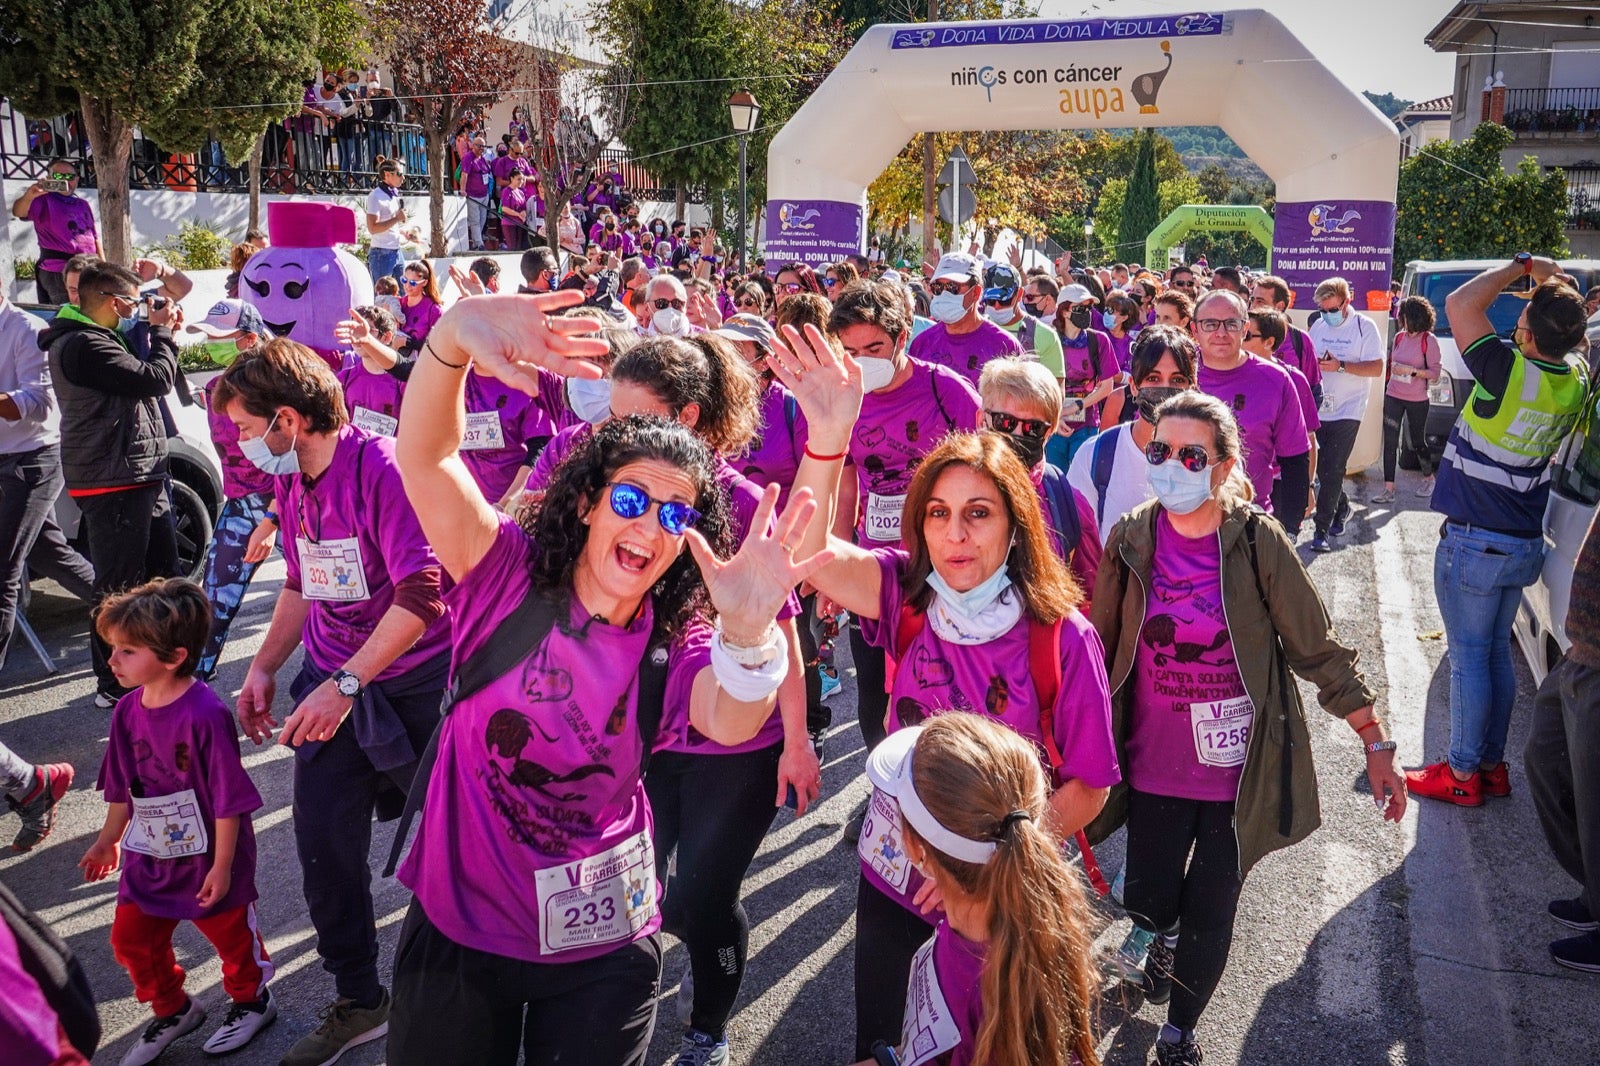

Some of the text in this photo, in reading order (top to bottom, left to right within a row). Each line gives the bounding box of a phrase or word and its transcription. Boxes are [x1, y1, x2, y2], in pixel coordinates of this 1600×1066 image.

[998, 26, 1035, 41] VIDA
[1101, 20, 1170, 36] MEDULA
[1013, 68, 1048, 84] con
[1054, 63, 1122, 83] cáncer
[1059, 86, 1125, 120] aupa
[1196, 208, 1247, 218] Diputación
[1194, 218, 1246, 227] de Granada
[790, 238, 818, 247] leucemia
[819, 240, 836, 248] 100%
[1324, 246, 1358, 254] leucemia
[1359, 246, 1376, 254] 100%
[804, 252, 830, 261] DONA
[1278, 258, 1386, 272] DONA MÉDULA, DONA VIDA
[870, 514, 900, 529] 1202
[309, 567, 329, 585] 323
[1210, 703, 1222, 718] V
[1204, 726, 1249, 749] 1258
[565, 862, 582, 887] V
[584, 859, 628, 884] CARRERA
[564, 896, 616, 929] 233
[568, 923, 614, 936] MARI TRINI
